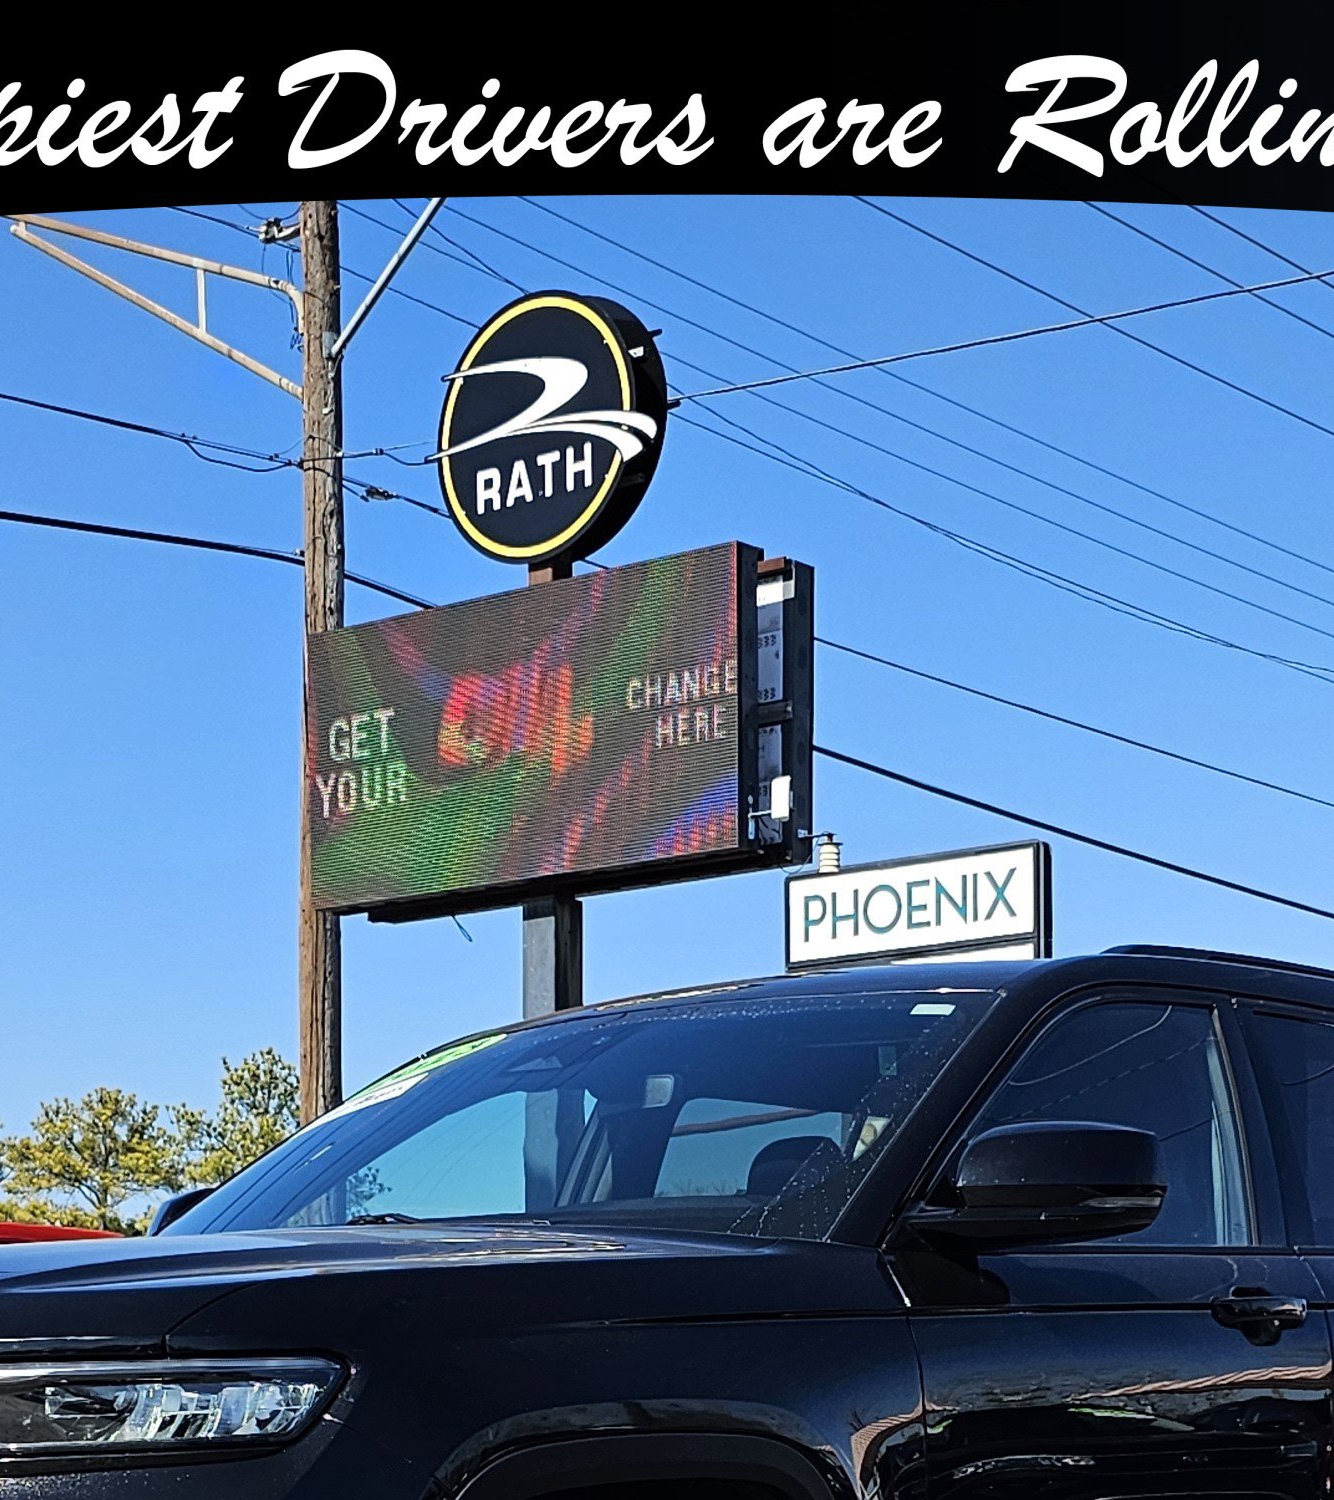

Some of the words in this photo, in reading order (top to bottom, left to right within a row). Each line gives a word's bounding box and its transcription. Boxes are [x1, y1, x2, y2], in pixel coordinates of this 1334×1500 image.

[476, 441, 593, 515] RATH
[627, 659, 738, 709] CHANGE
[329, 707, 395, 760] GET
[656, 703, 727, 748] HERE
[315, 760, 408, 819] YOUR
[804, 867, 1017, 943] PHOENIX
